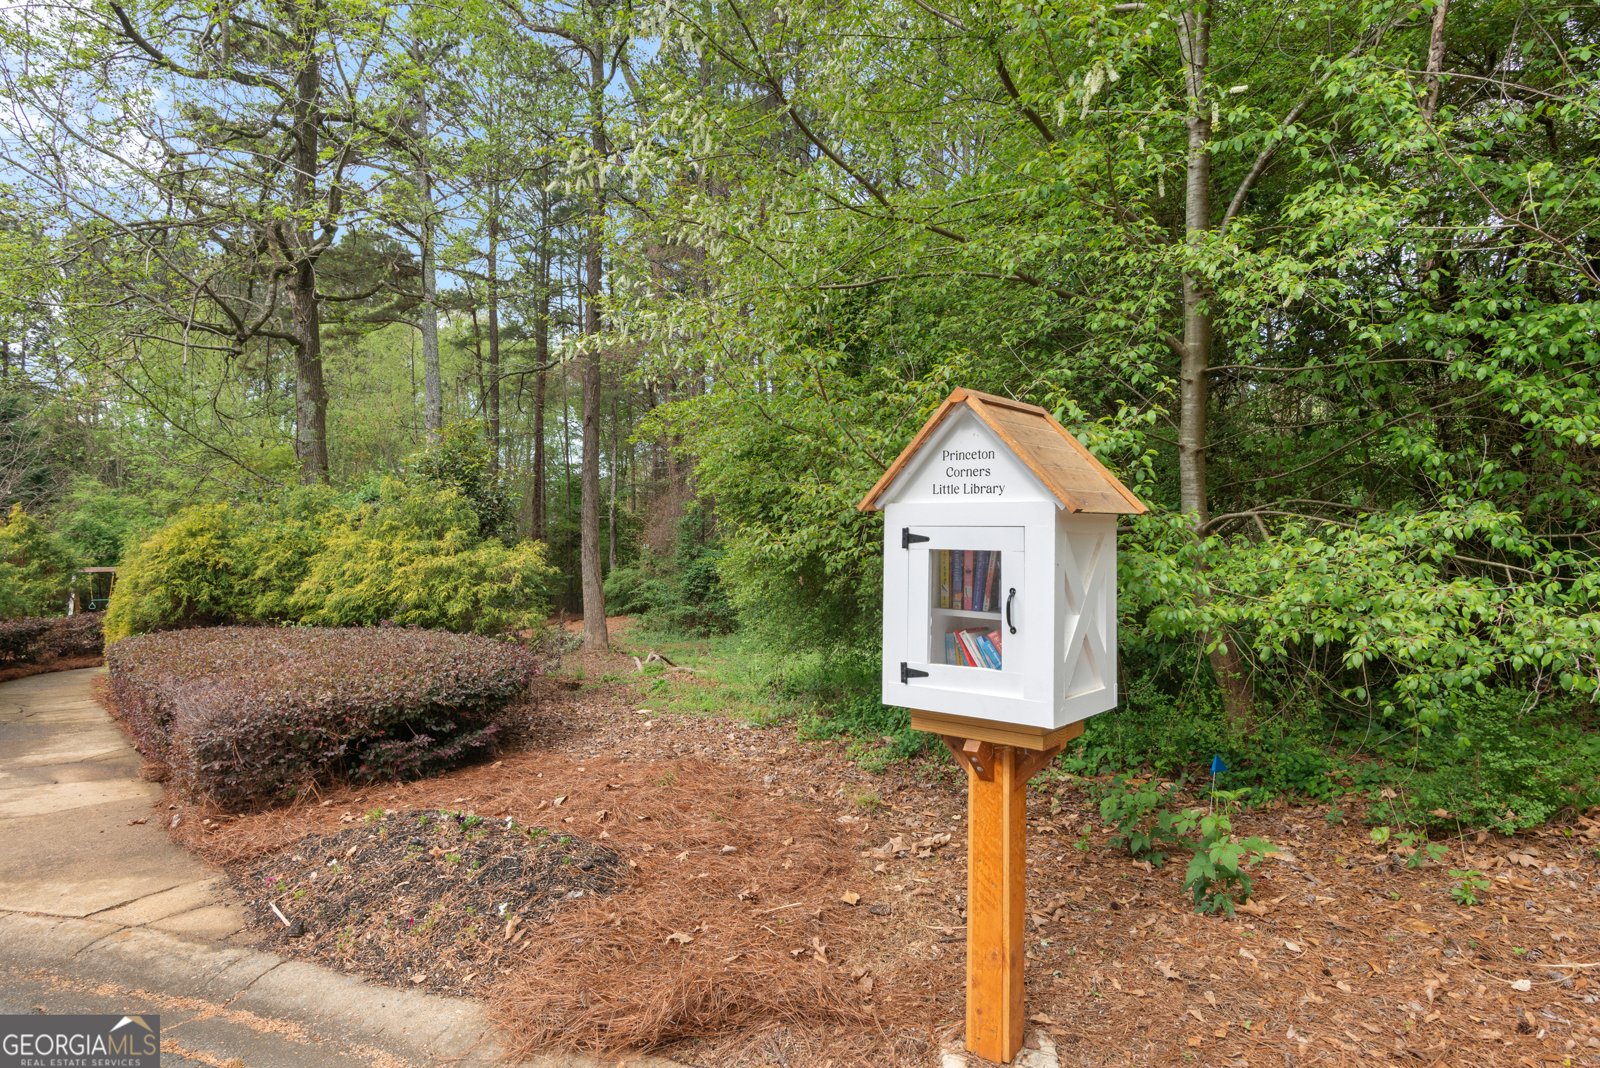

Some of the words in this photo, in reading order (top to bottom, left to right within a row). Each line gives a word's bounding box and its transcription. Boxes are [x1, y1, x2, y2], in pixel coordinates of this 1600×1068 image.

[942, 450, 995, 461] Princeton
[946, 466, 991, 477] Corners
[932, 483, 960, 495] Little
[963, 483, 1006, 496] Library
